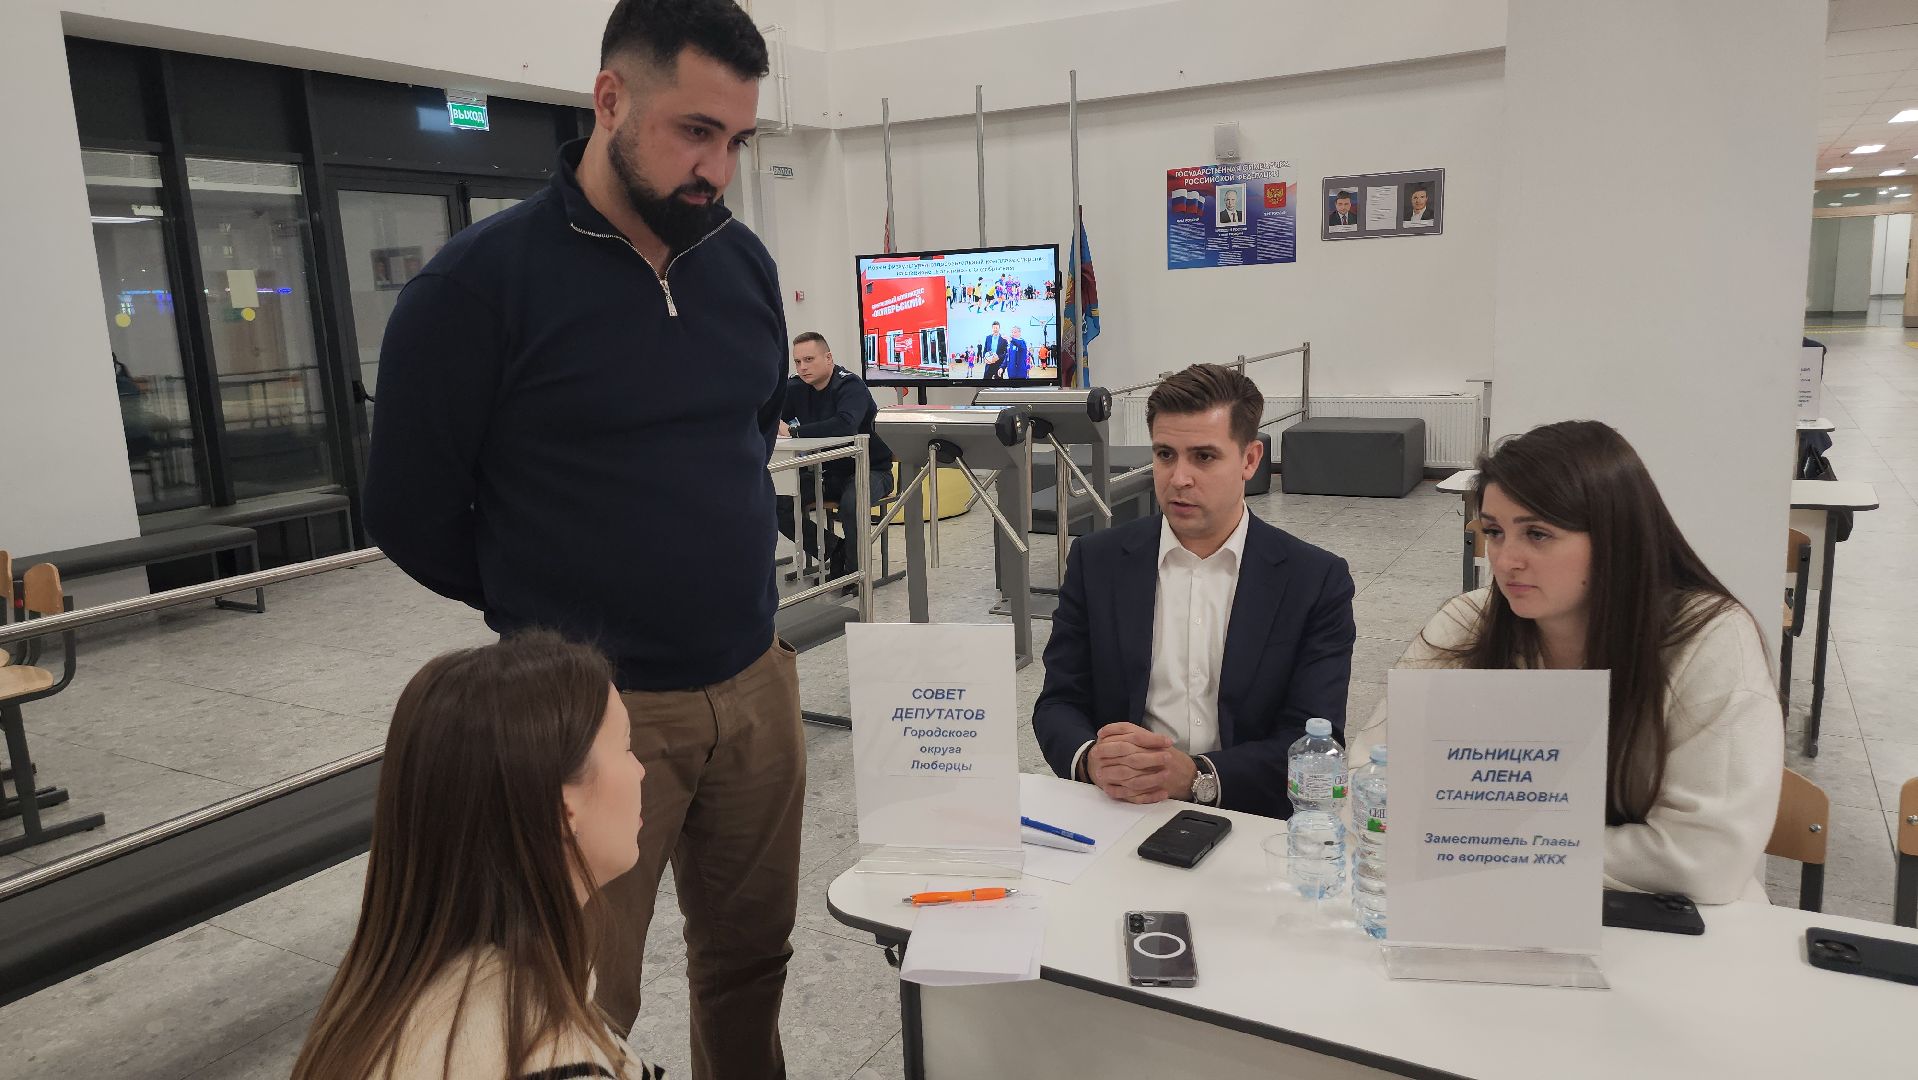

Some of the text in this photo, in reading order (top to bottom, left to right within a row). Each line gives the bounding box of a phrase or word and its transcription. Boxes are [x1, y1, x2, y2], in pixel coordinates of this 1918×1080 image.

[452, 108, 484, 123] ВЫХОД
[1175, 165, 1241, 177] ГОСУДАРСТВЕННАЯ
[1184, 174, 1235, 186] РОССИЙСКОЙ
[912, 688, 966, 700] СОВЕТ
[891, 707, 986, 722] ДЕПУТАТОВ
[903, 726, 977, 739] Городского
[919, 745, 962, 756] округа
[1447, 748, 1560, 764] ИЛЬНИЦКАЯ
[911, 759, 972, 772] Люберцы
[1471, 769, 1533, 783] АЛЕНА
[1436, 789, 1569, 802] СТАНИСЛАВОВНА
[1424, 832, 1580, 847] Заместитель Главы
[1437, 853, 1567, 864] по вопросам ЖКХ
